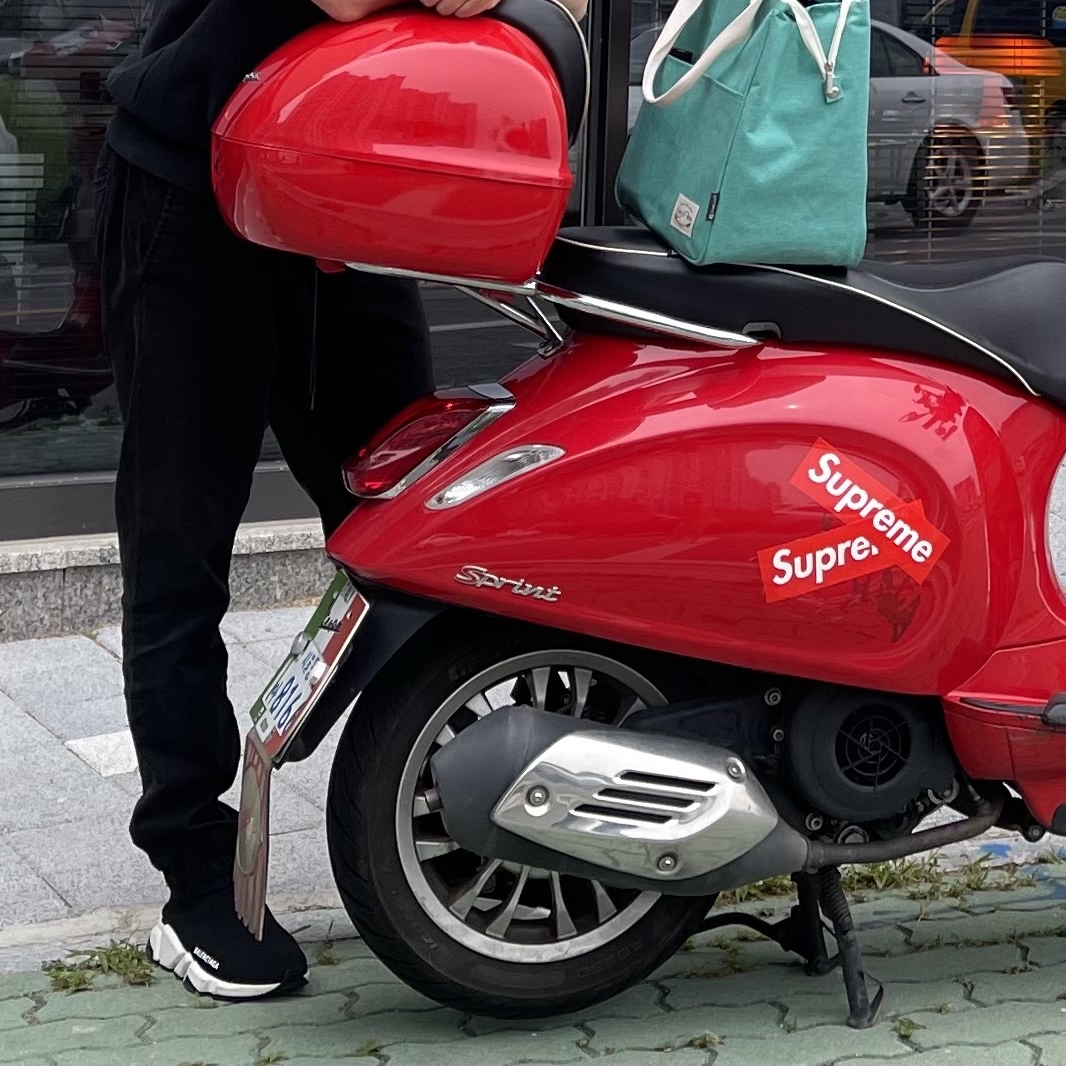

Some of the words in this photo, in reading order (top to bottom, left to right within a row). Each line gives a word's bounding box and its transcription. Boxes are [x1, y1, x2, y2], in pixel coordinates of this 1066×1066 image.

[808, 452, 933, 563] Supreme
[454, 565, 562, 601] Sprint
[772, 536, 879, 585] Supre
